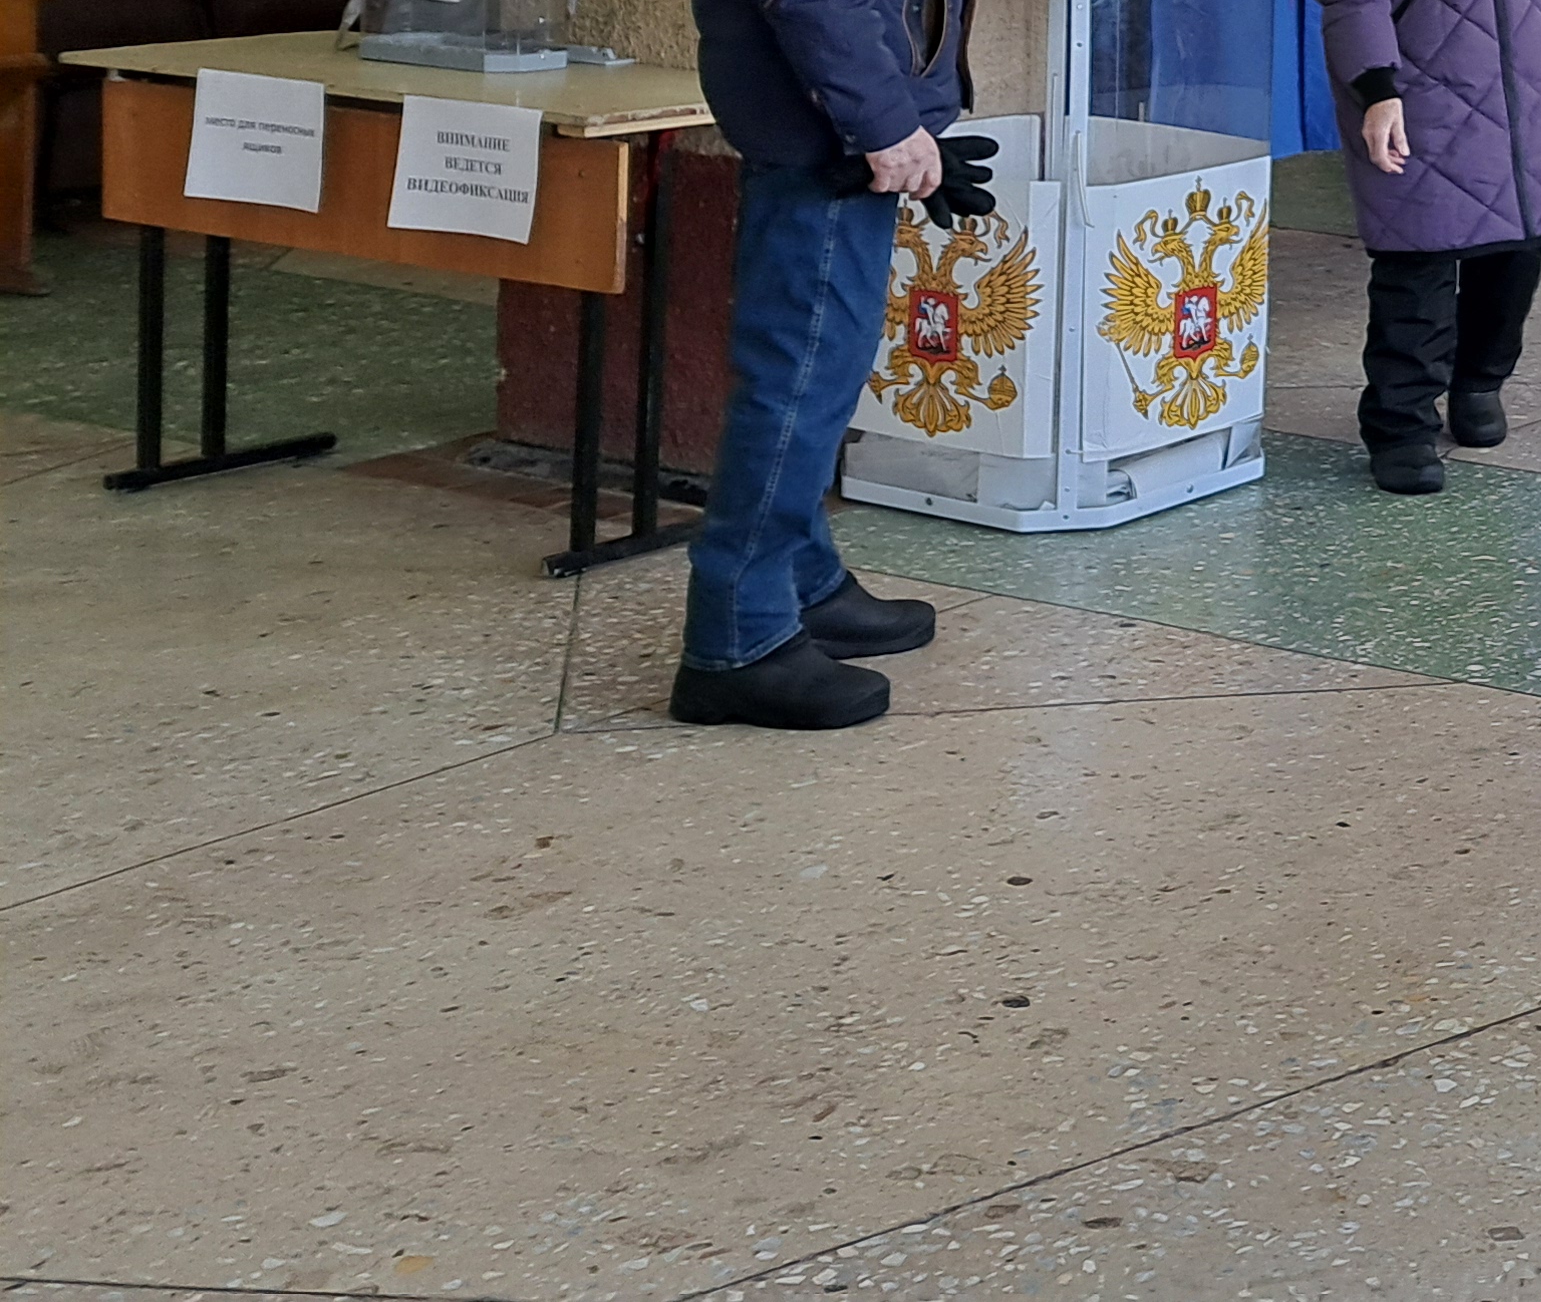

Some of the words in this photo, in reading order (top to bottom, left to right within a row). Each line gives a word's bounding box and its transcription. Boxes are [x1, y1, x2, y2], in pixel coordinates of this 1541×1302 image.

[437, 131, 511, 152] ВНИМАНИЕ
[445, 157, 502, 175] ВЕДЕТСЯ
[407, 178, 529, 204] ВИДЕОФИКСАЦИЯ
